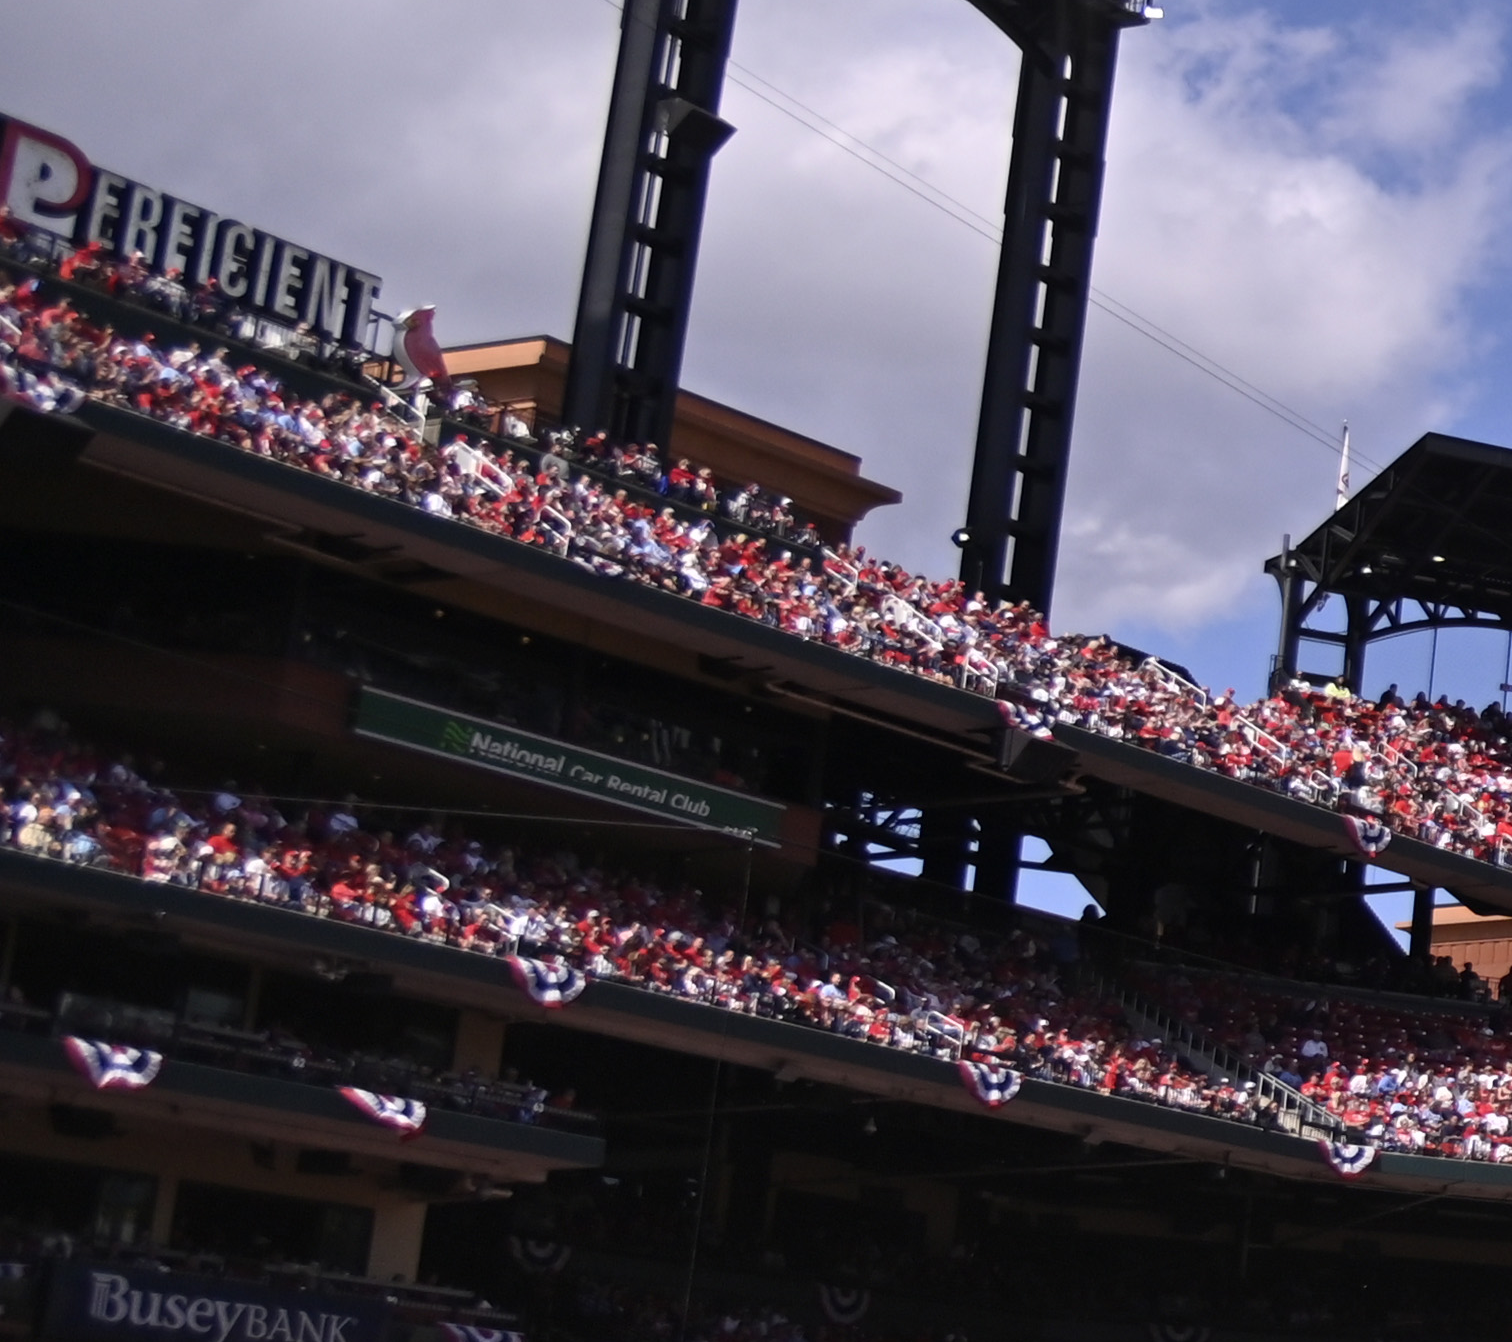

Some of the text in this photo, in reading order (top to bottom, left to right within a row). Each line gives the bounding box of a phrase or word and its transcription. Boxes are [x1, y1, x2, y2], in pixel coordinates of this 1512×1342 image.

[471, 732, 711, 817] National Car Rental Club
